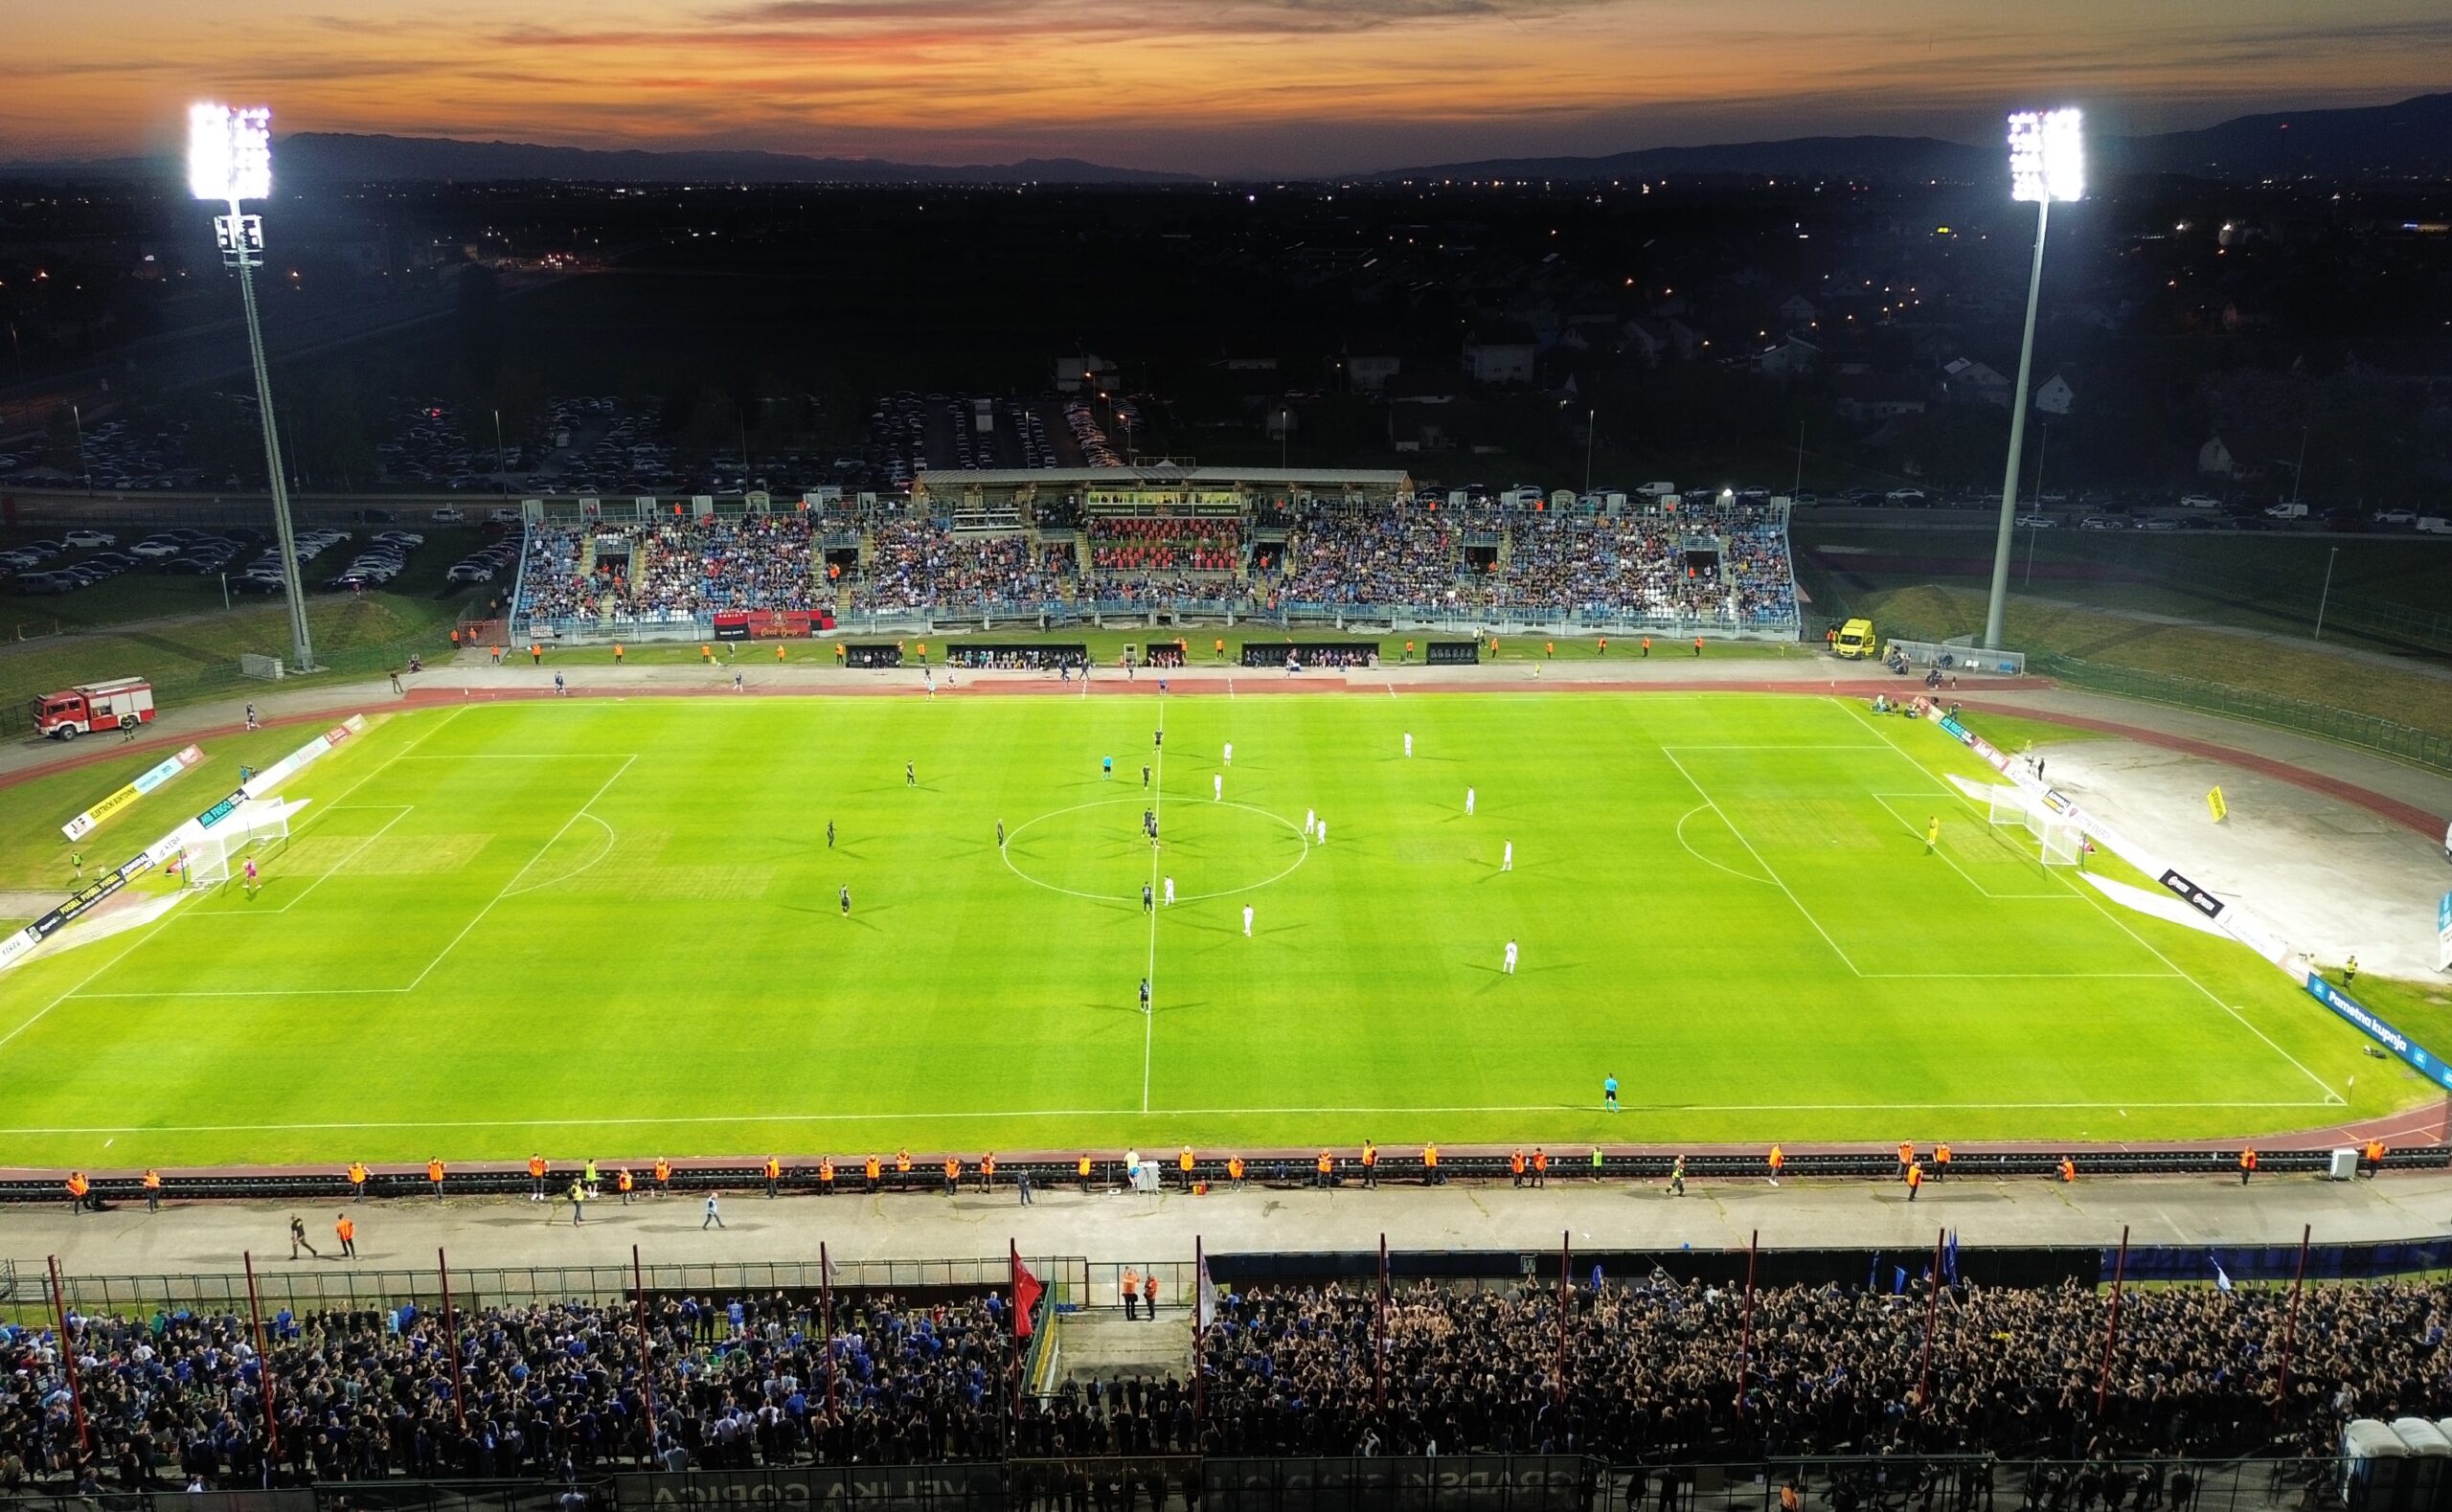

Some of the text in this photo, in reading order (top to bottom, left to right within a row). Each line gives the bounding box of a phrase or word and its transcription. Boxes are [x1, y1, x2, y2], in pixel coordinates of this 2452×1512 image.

[210, 801, 233, 819] FRIGO
[120, 853, 150, 876] ADMIRAL
[58, 897, 82, 914] PIXSELL
[80, 884, 102, 902] PIXSELL
[99, 872, 121, 889] PIXSELL
[2328, 990, 2408, 1052] Pametna kupnja
